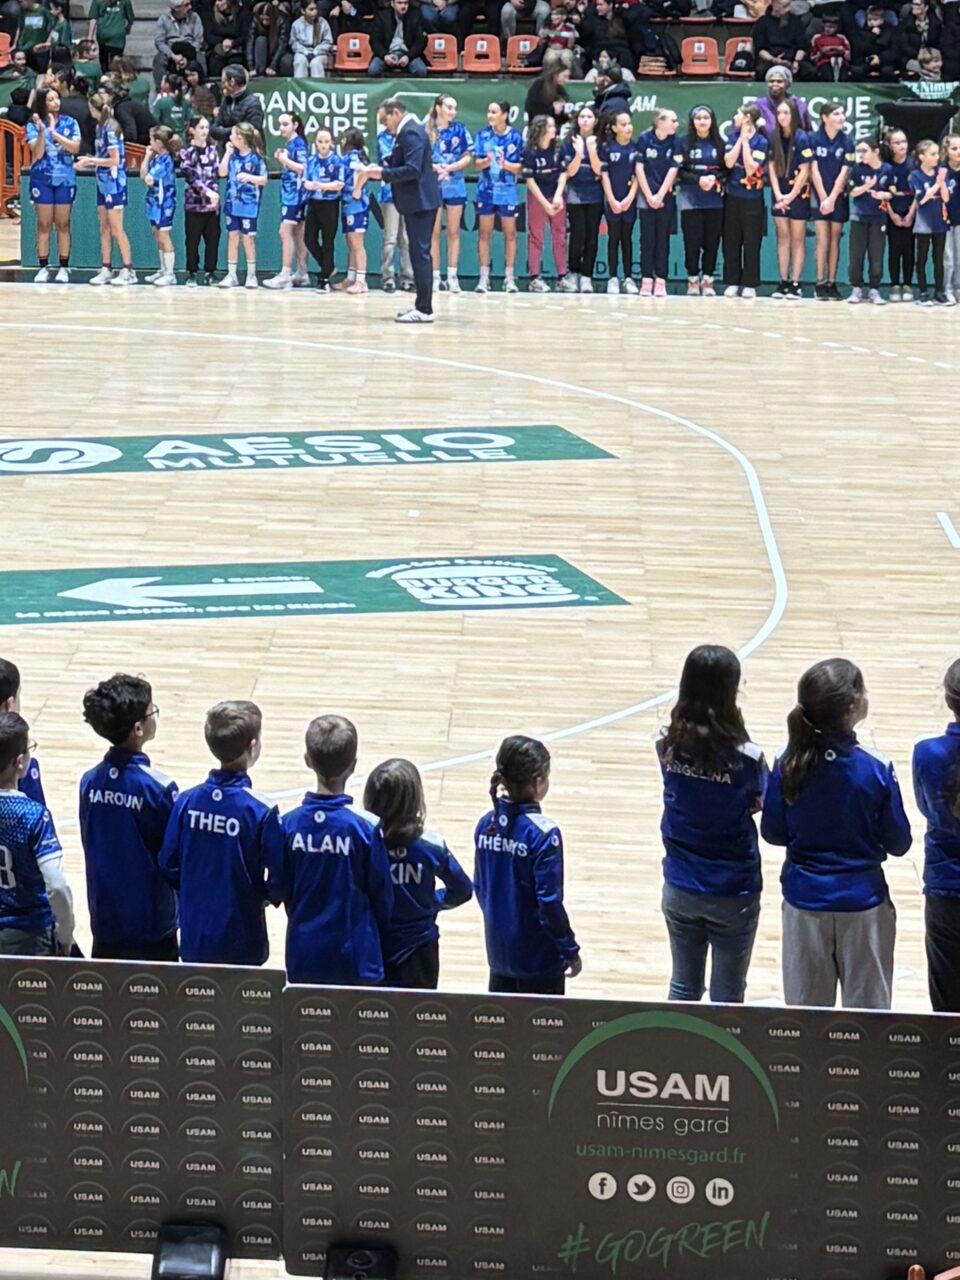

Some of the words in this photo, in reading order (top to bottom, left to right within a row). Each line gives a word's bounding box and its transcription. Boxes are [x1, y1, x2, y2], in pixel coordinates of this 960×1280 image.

[146, 447, 517, 470] MUTUELLE
[406, 583, 574, 600] KING
[291, 832, 350, 857] ALAN
[597, 1069, 730, 1102] USAM
[597, 1111, 664, 1131] nîmes
[674, 1116, 729, 1136] gard
[576, 1143, 746, 1165] usam-nimesgard.fr
[558, 1211, 770, 1275] #GOGREEN
